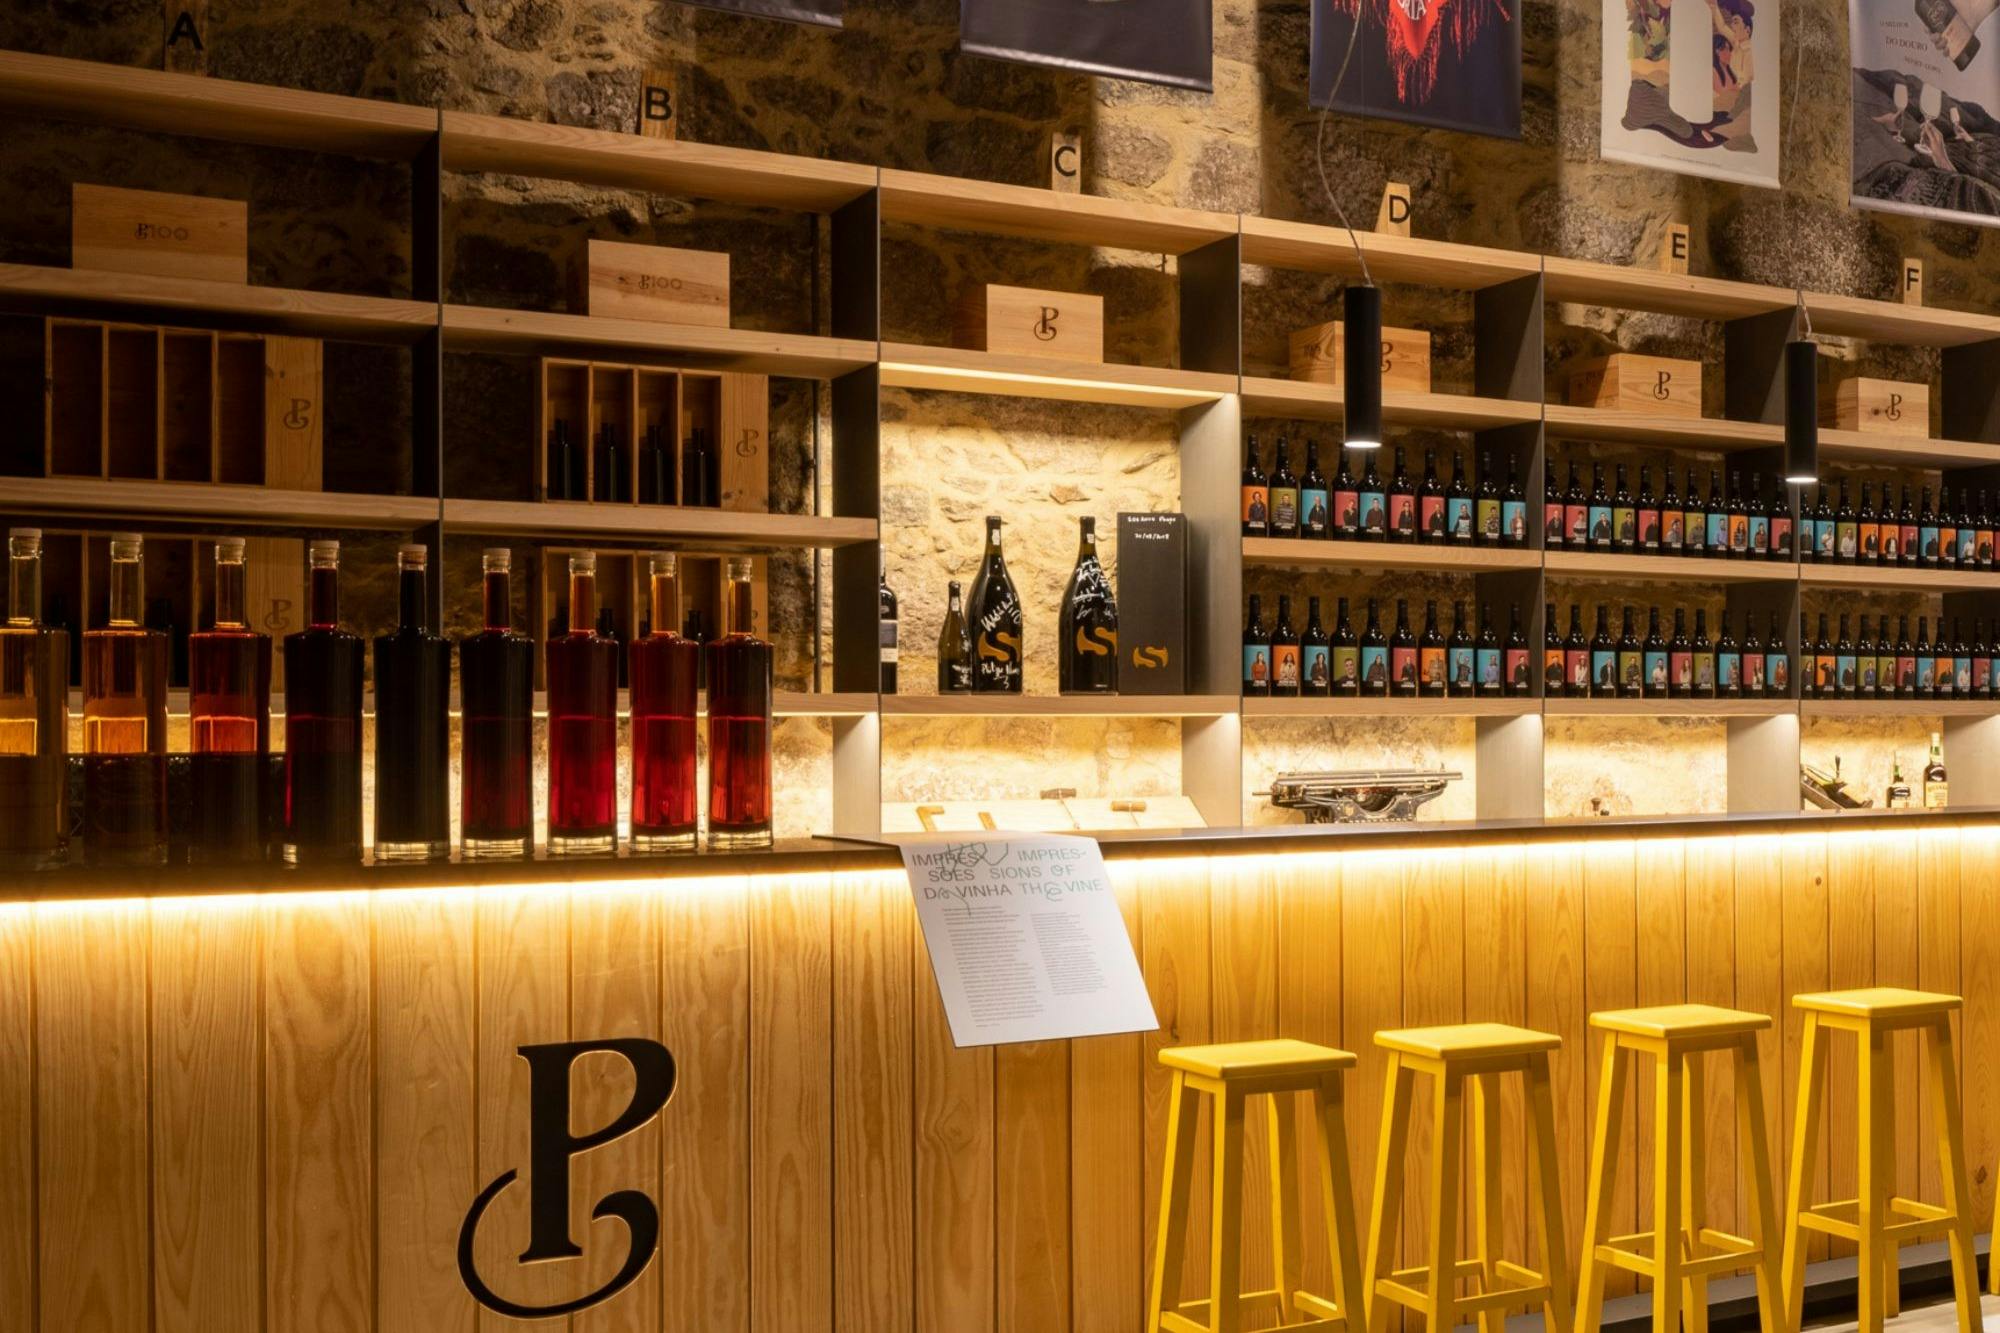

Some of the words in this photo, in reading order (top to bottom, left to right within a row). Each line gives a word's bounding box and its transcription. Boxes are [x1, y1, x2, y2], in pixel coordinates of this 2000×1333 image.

[168, 12, 203, 50] A
[1900, 39, 1928, 51] DOURO
[645, 87, 672, 120] B
[1054, 145, 1077, 178] C
[1389, 195, 1410, 224] D
[1672, 233, 1686, 259] E
[1906, 267, 1919, 291] F
[1018, 848, 1087, 862] IMPRES-
[990, 865, 1042, 880] SIONS
[1051, 864, 1077, 877] OF
[955, 884, 1013, 899] VINHA
[1064, 880, 1105, 893] VINE
